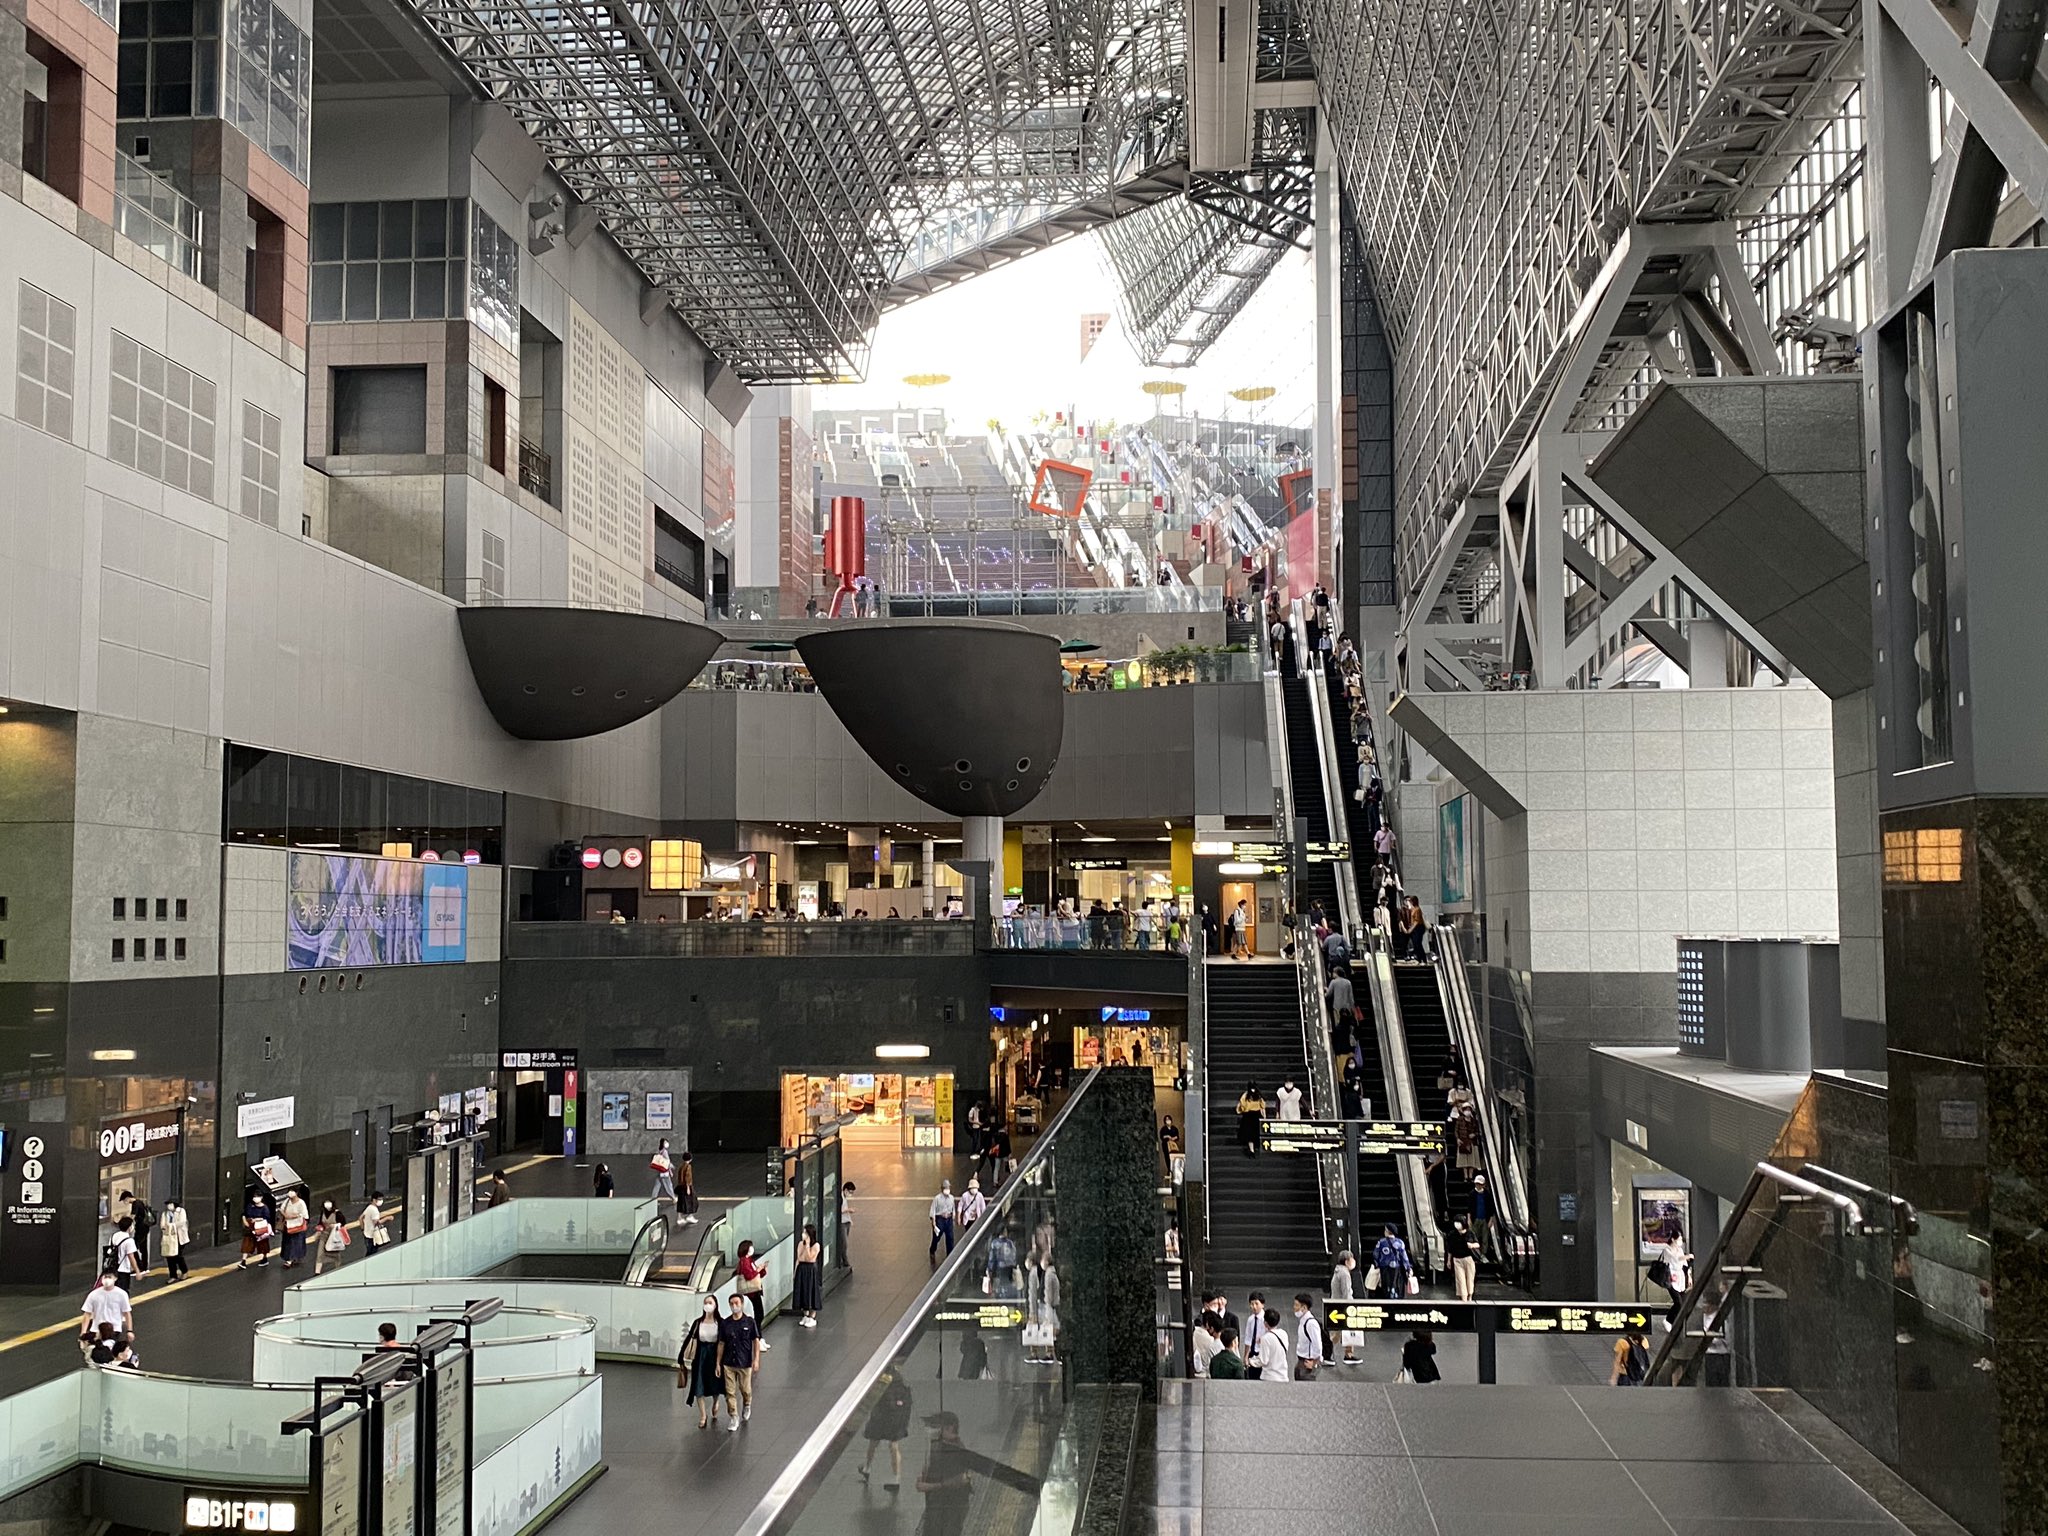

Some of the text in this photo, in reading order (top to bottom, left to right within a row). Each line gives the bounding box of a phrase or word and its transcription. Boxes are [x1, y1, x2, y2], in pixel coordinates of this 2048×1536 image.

[7, 1206, 56, 1214] JR Information
[209, 1500, 244, 1528] B1F
